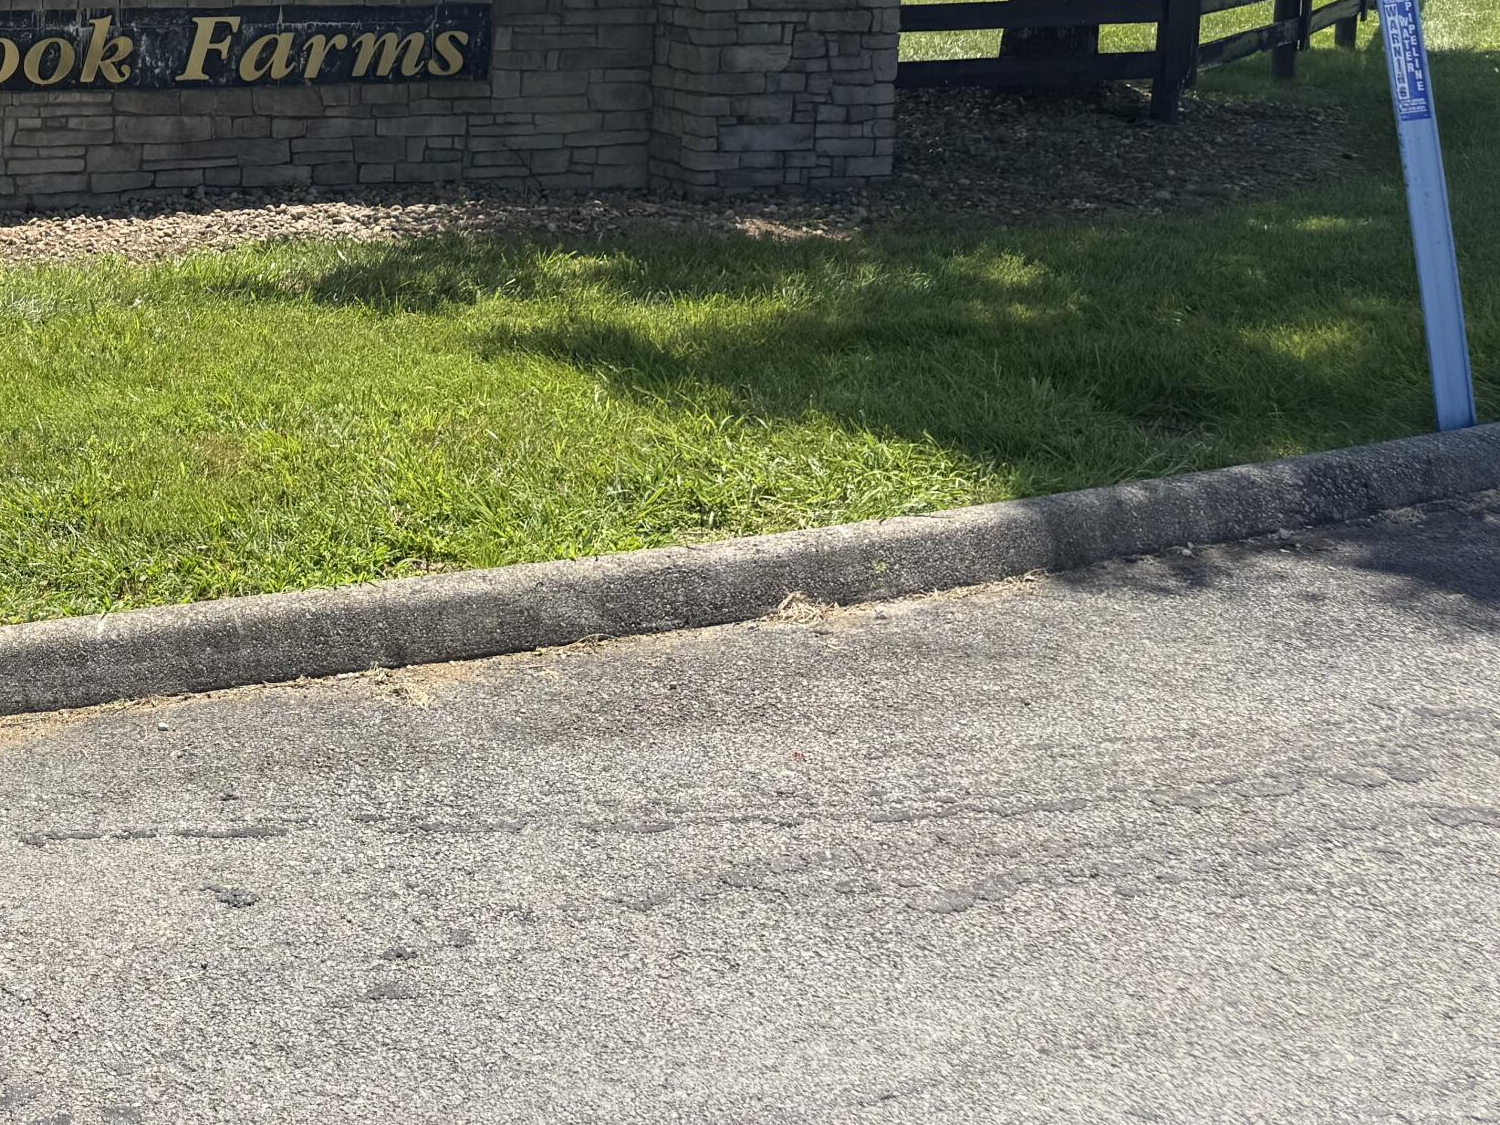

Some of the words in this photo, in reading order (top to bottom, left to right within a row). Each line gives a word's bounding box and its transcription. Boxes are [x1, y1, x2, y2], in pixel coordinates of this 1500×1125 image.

[175, 16, 469, 81] Farms
[1385, 5, 1408, 98] WARNING
[1400, 16, 1415, 73] WATER
[1405, 1, 1425, 91] PIPELINE
